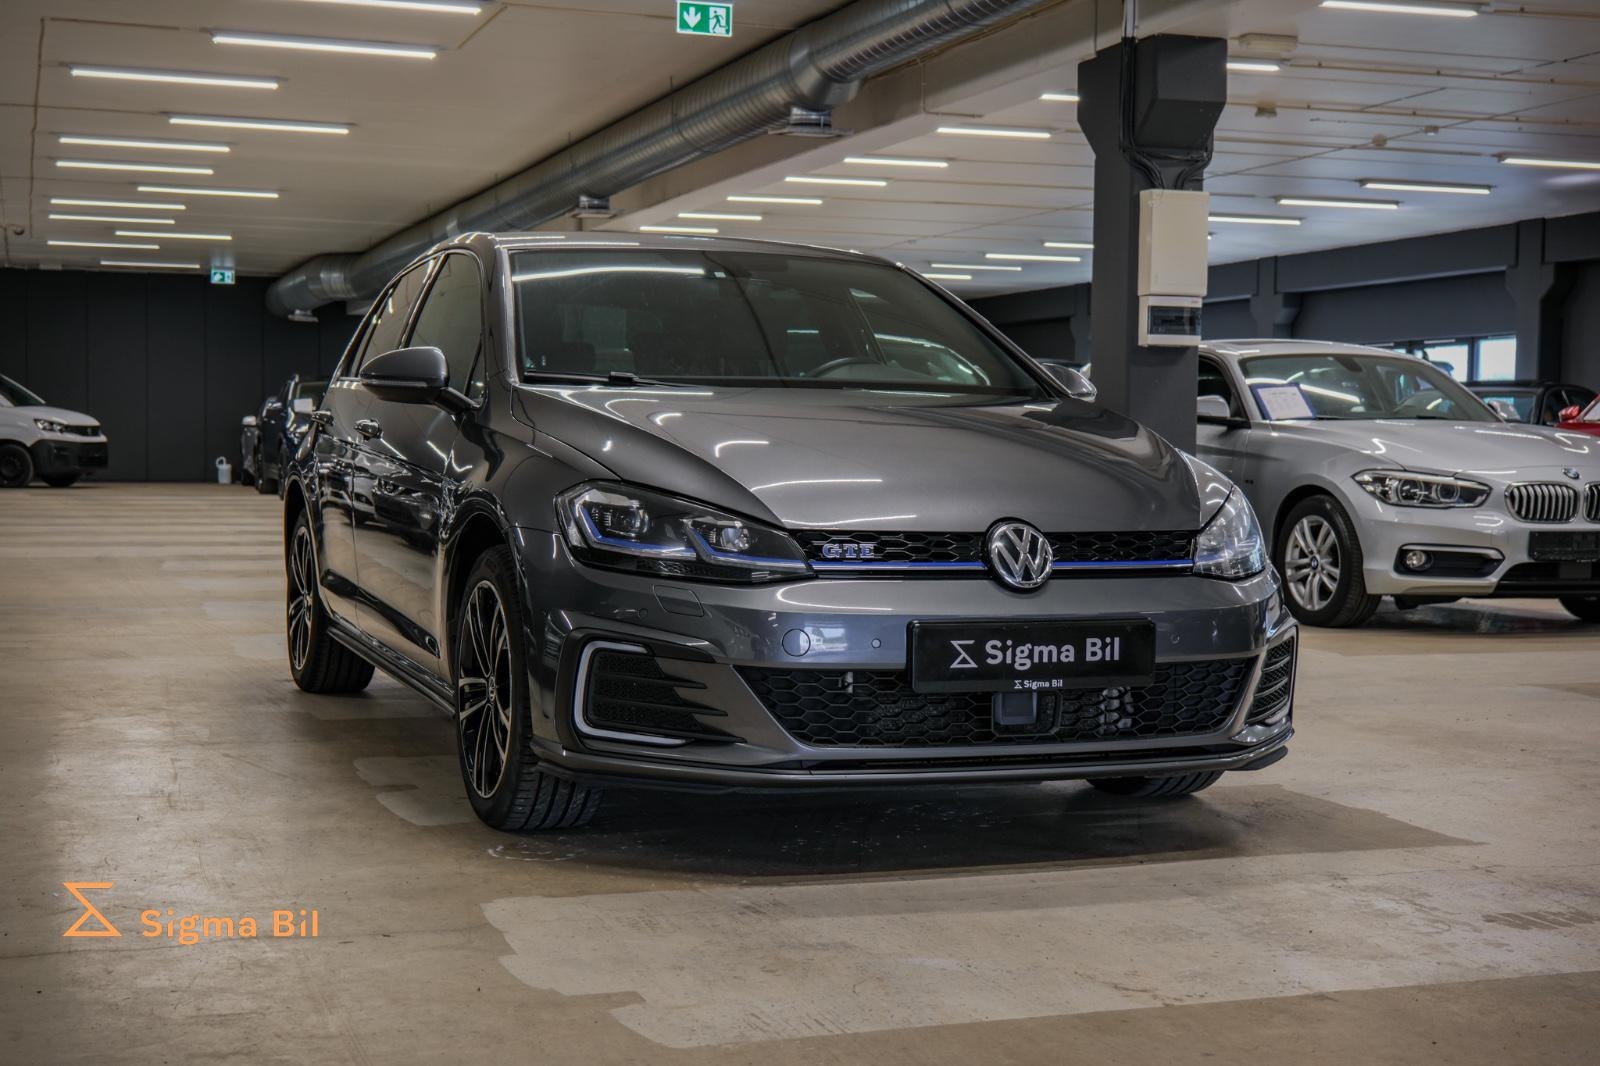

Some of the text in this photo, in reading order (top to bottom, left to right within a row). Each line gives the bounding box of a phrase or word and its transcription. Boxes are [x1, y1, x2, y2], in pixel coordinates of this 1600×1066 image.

[822, 543, 875, 559] GTE
[984, 636, 1120, 671] Sigma Bil
[1023, 679, 1063, 690] Sigma Bil
